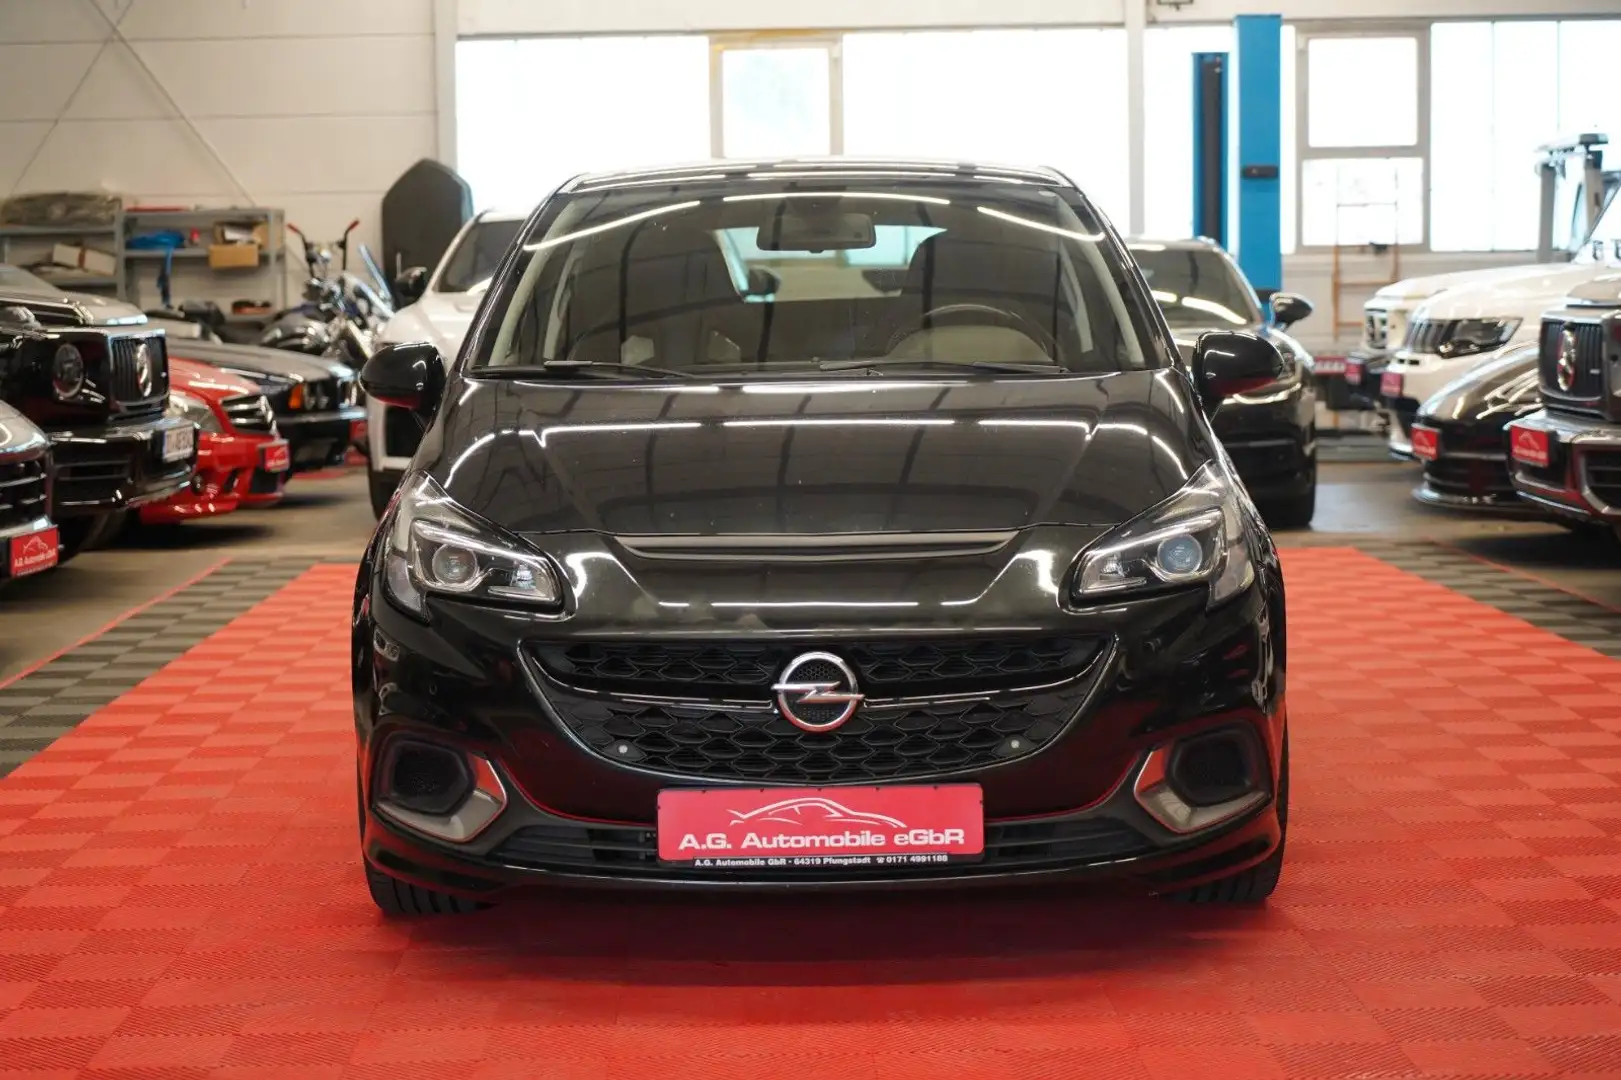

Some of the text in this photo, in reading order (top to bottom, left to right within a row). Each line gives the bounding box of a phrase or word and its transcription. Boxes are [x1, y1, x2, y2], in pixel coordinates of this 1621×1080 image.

[678, 828, 965, 850] A.G. Automobile eGbR
[694, 859, 713, 867] A.G.
[715, 858, 765, 866] Automobile
[767, 858, 786, 866] GbR
[793, 857, 821, 865] 64319
[822, 857, 871, 865] Pfungstadt
[886, 855, 907, 863] 0171
